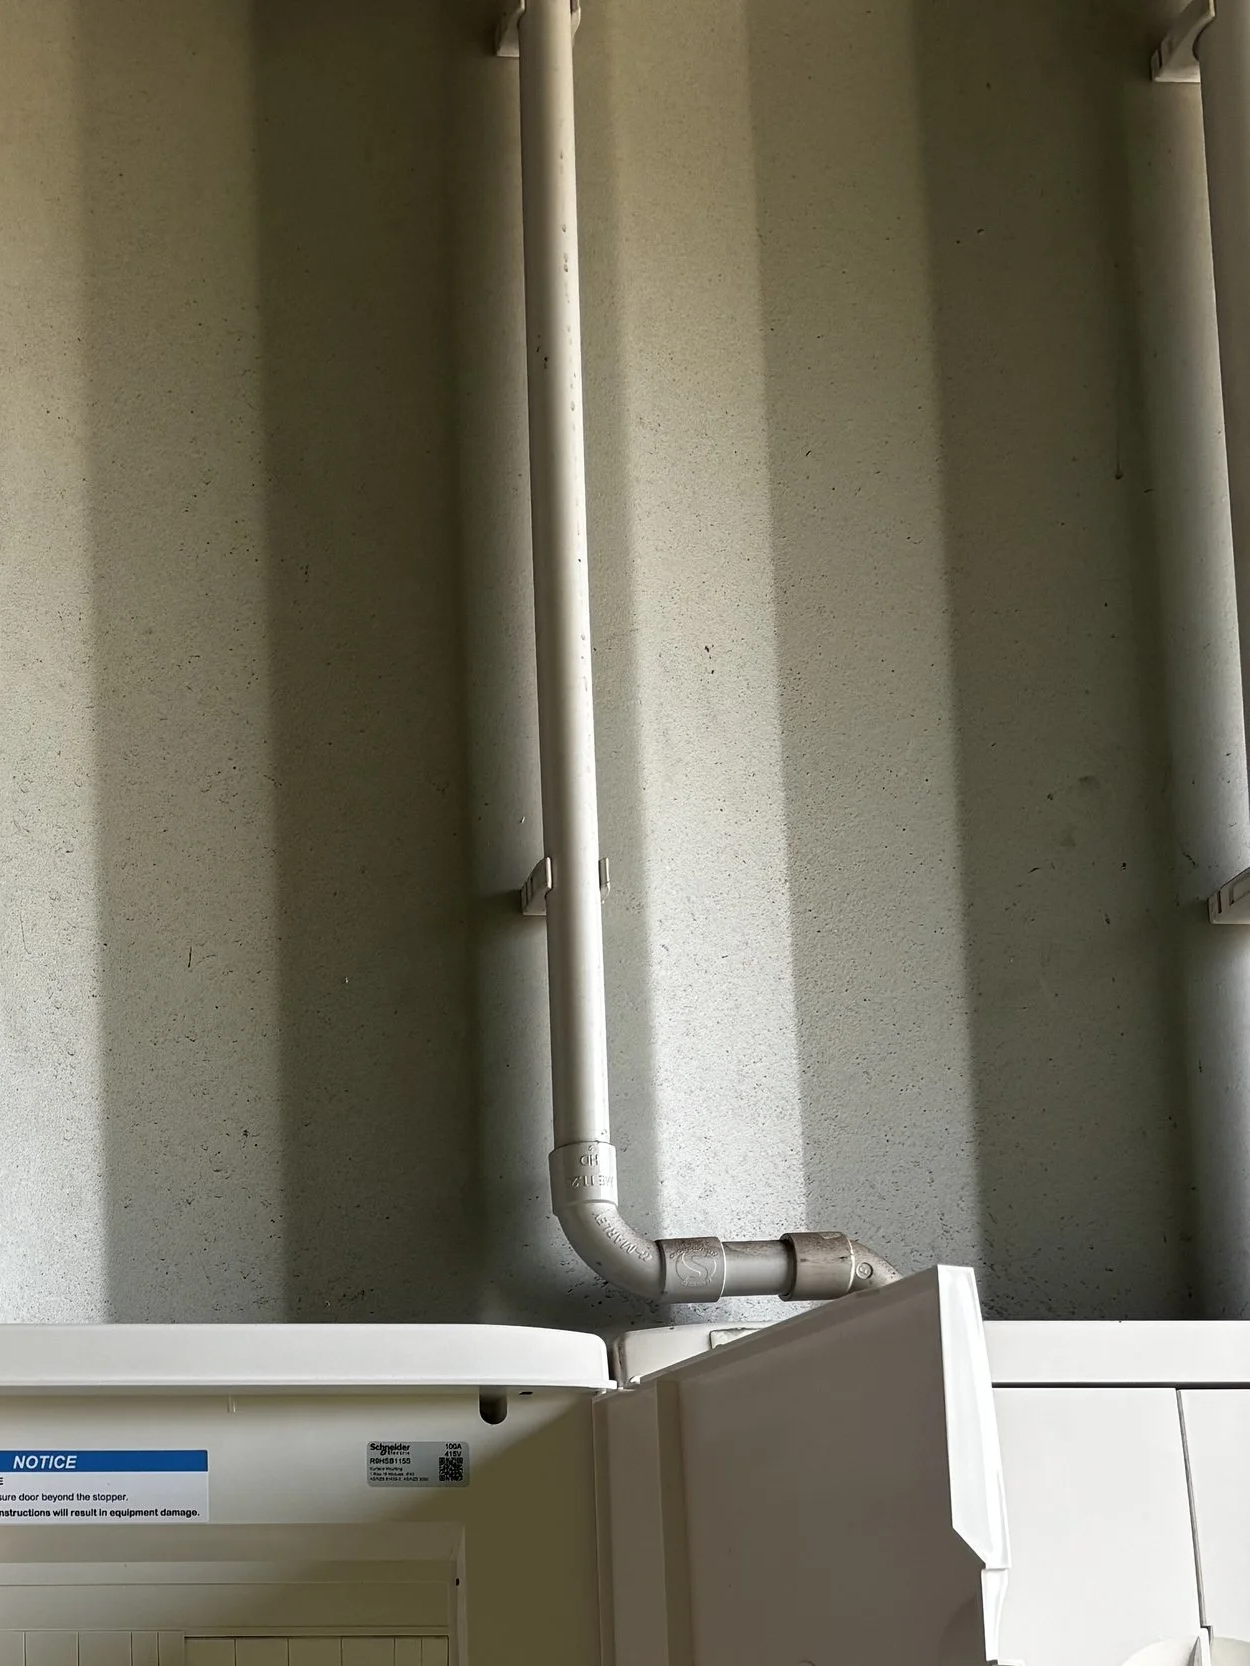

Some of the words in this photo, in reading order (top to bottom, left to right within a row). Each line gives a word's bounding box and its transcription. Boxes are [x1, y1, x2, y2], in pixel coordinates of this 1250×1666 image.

[370, 1443, 410, 1453] Schneider
[13, 1455, 78, 1469] NOTICE
[18, 1493, 39, 1501] door
[42, 1493, 74, 1503] beyond
[76, 1493, 90, 1501] the
[92, 1494, 128, 1503] stopper.
[52, 1508, 68, 1516] will
[70, 1508, 97, 1516] result
[99, 1508, 108, 1516] in
[110, 1508, 158, 1518] equipment
[160, 1508, 200, 1518] damage.
